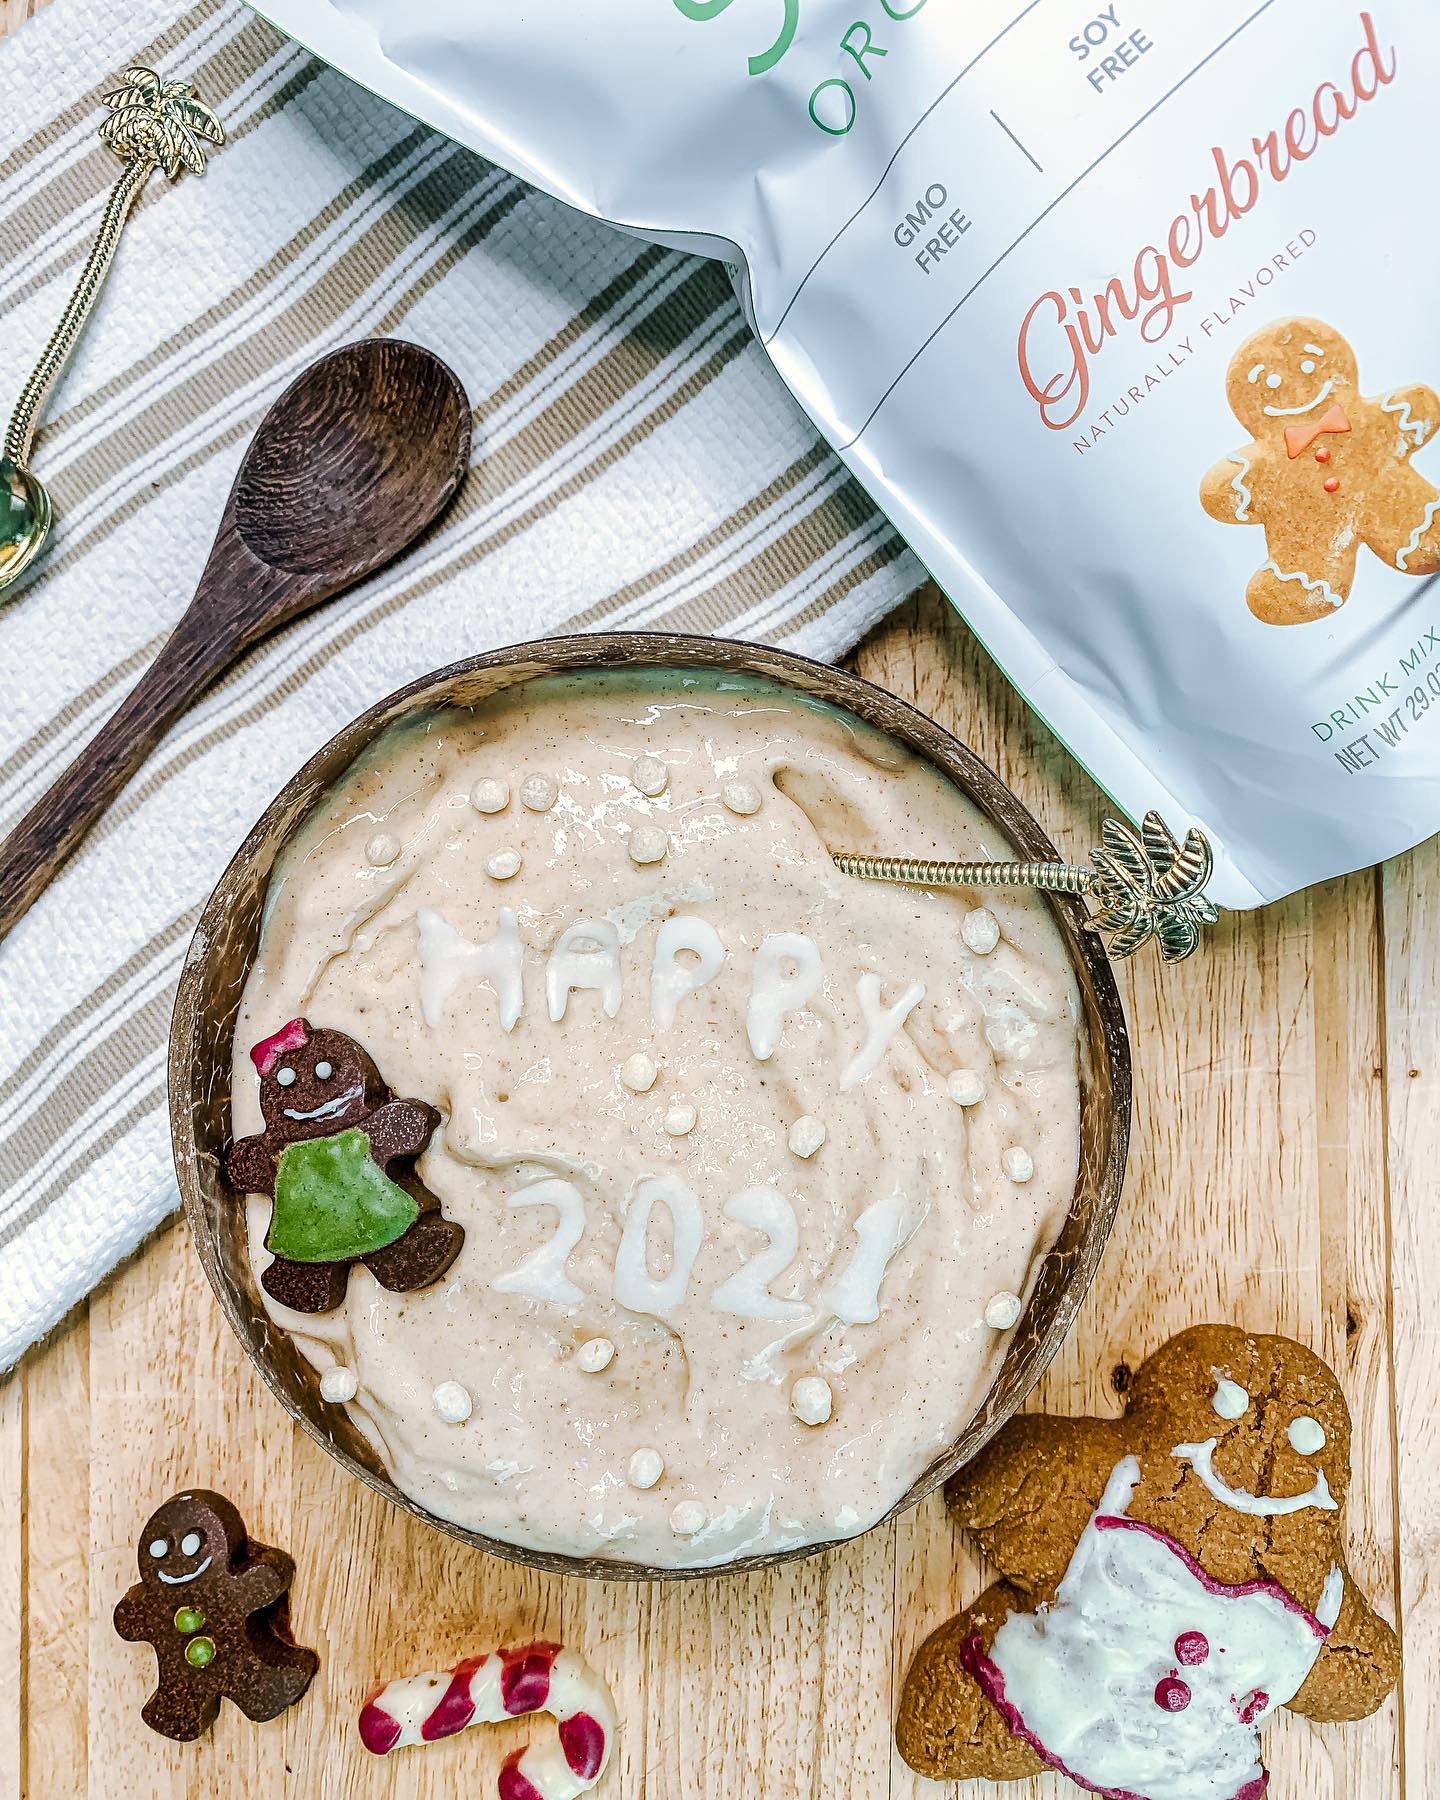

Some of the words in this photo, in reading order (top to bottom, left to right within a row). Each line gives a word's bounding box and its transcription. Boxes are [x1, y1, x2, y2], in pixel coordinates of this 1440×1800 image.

[808, 0, 930, 136] OR
[1069, 3, 1120, 60] SOY
[1086, 28, 1154, 93] FREE
[894, 183, 947, 247] GMO
[915, 208, 972, 274] FREE
[1017, 12, 1397, 430] Gingerbread
[1073, 336, 1195, 455] NATURALLY
[1200, 229, 1317, 337] FLAVORED
[1311, 672, 1399, 742] DRINK
[1399, 625, 1440, 676] MIX
[1334, 734, 1380, 774] NET
[1373, 707, 1409, 747] WT
[416, 906, 927, 1091] HAPPY
[493, 1176, 903, 1325] 2021
